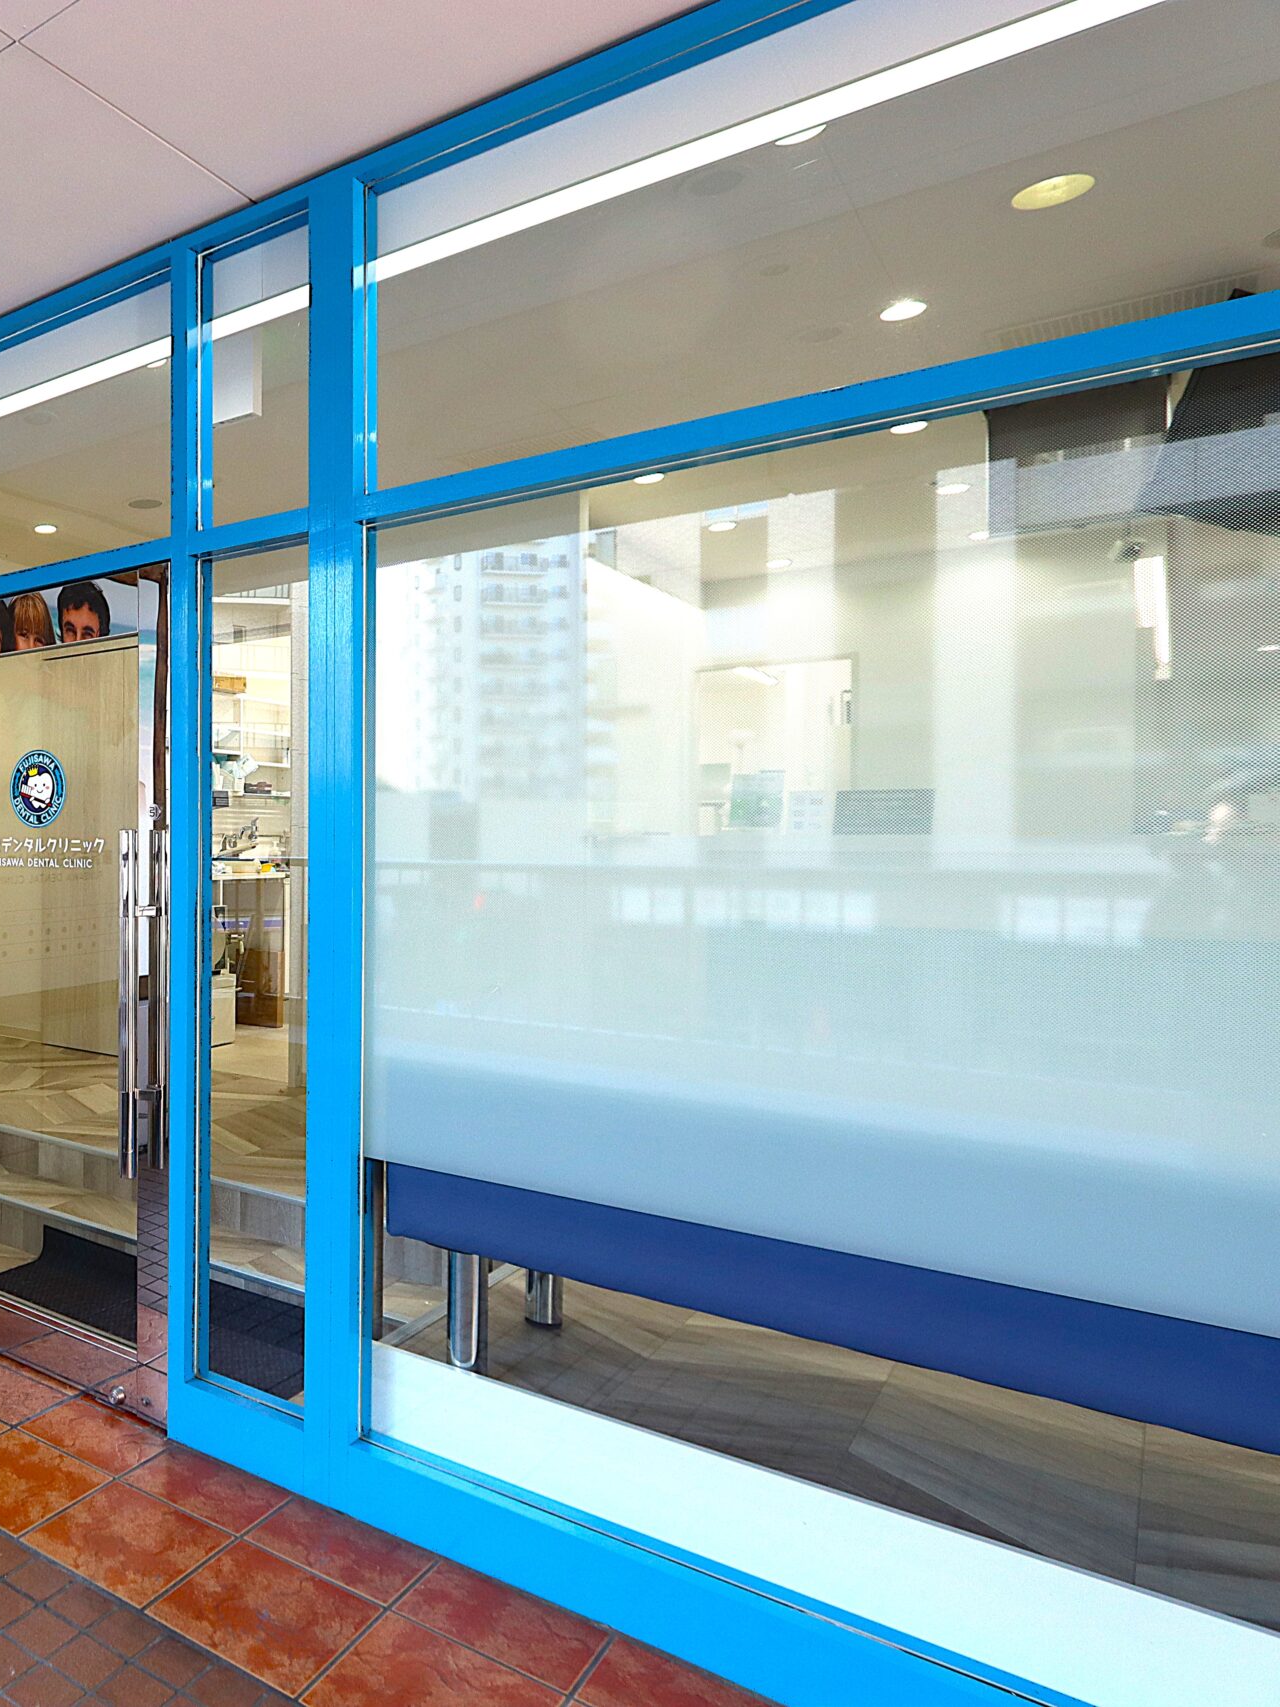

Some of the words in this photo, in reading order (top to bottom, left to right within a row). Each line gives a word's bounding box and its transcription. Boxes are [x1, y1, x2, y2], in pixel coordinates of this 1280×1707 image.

[19, 754, 56, 773] FUJISAWA
[14, 797, 39, 824] DENTAL
[40, 797, 62, 823] CLINIC
[28, 858, 59, 868] DENTAL
[63, 859, 93, 869] CLINIC
